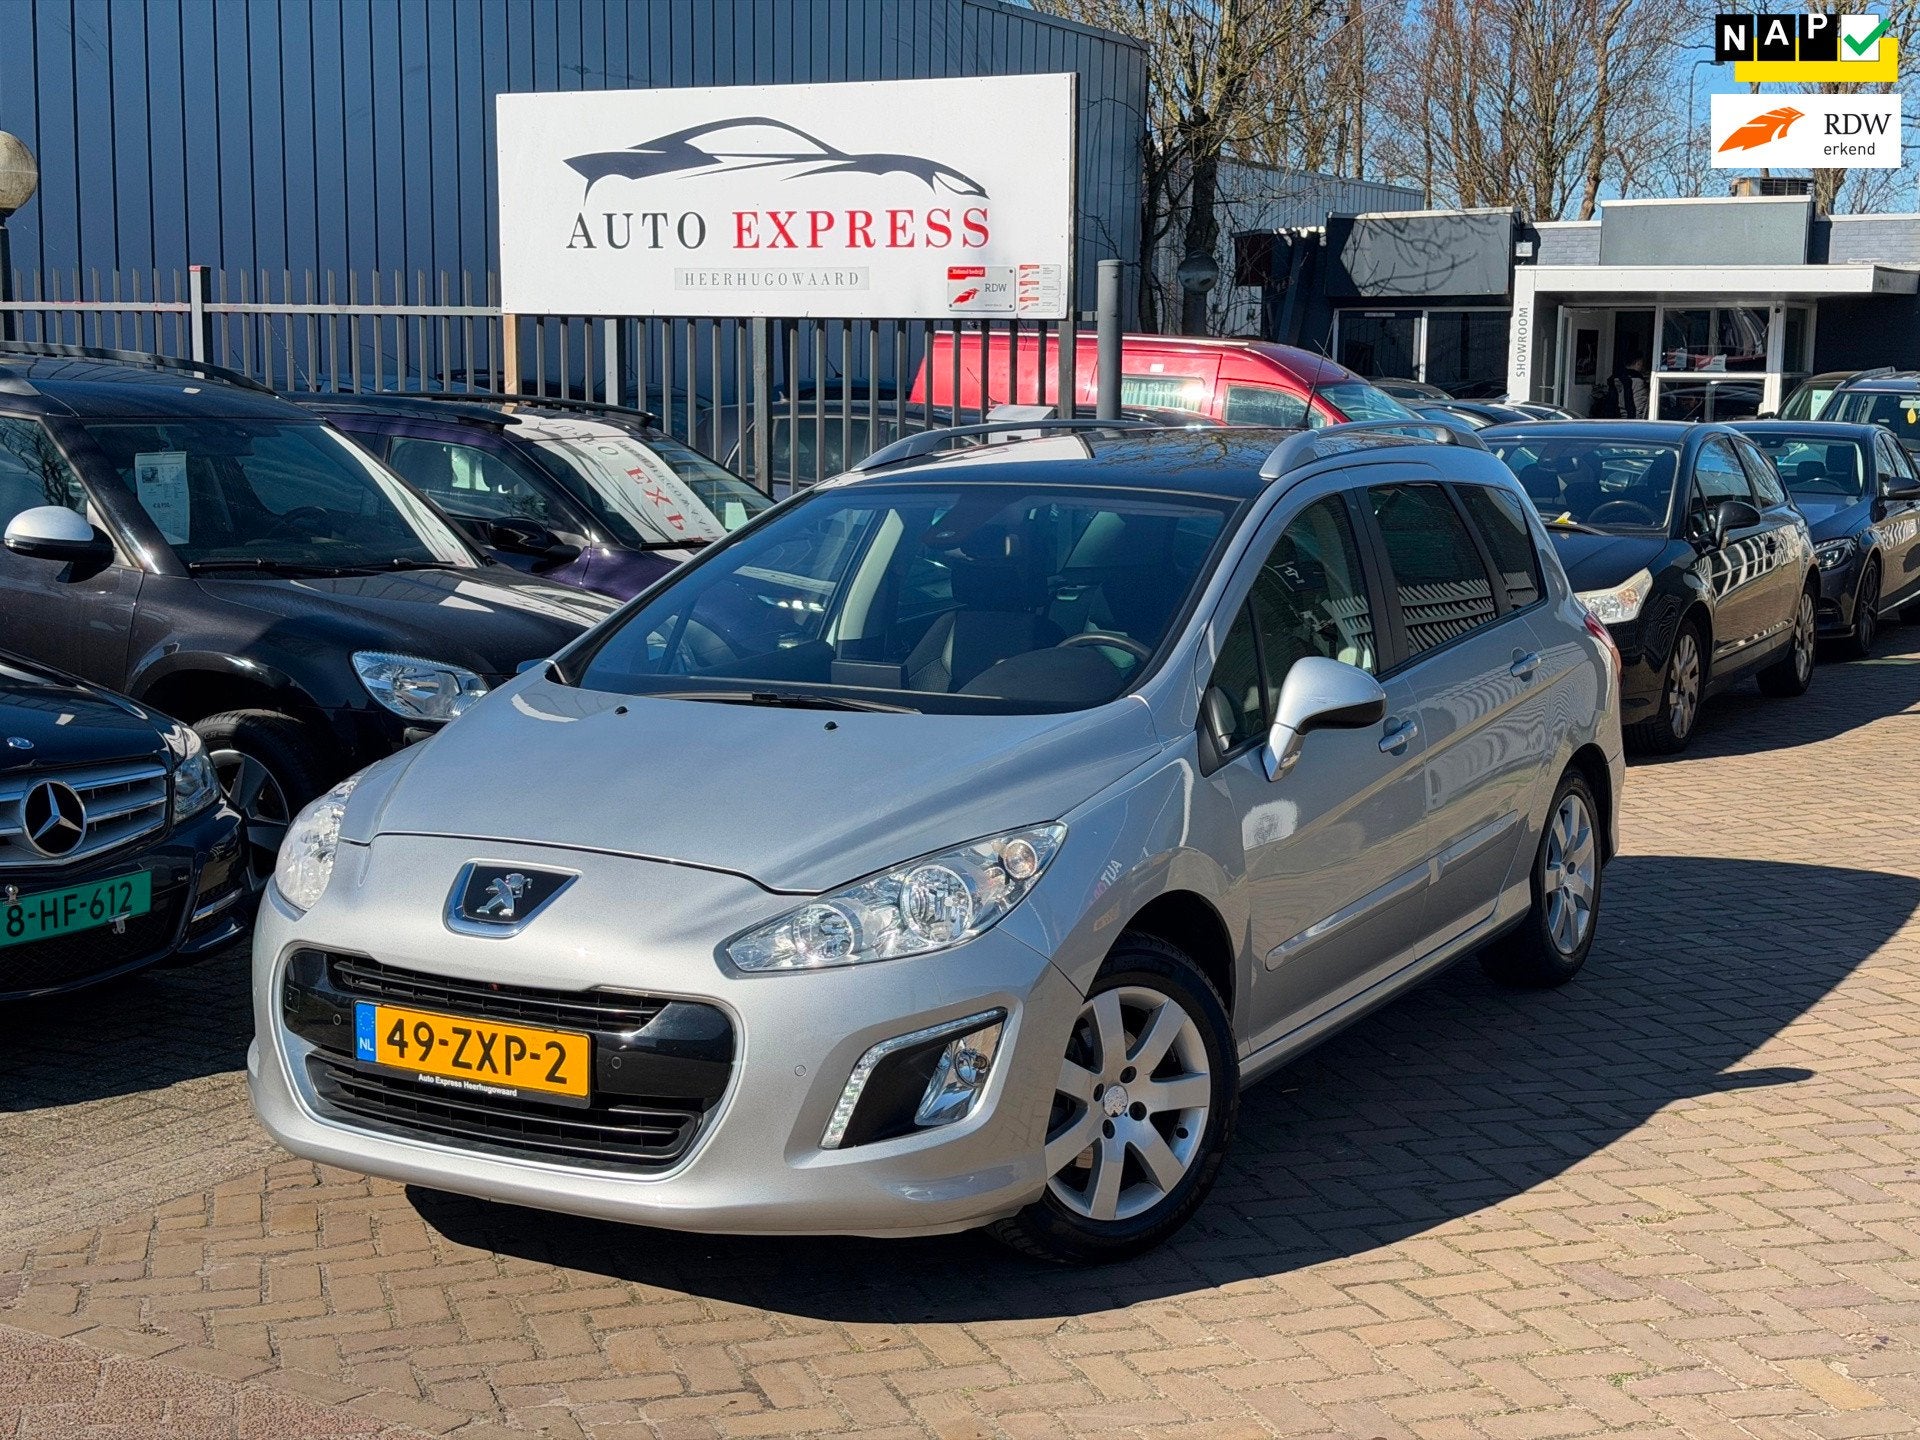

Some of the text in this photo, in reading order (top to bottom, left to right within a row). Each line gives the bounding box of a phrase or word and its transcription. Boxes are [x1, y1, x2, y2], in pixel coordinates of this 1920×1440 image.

[566, 207, 991, 250] AUTO EXPRESS
[684, 271, 860, 287] HEERHUGOWAARD
[984, 283, 1007, 293] RDW
[1515, 307, 1528, 378] SHOWROOM
[6, 881, 133, 937] 8-HF-612
[359, 1037, 375, 1052] NL
[386, 1018, 568, 1085] 49-ZXP-2
[418, 1073, 518, 1097] Auto Express Heerhugowaard
